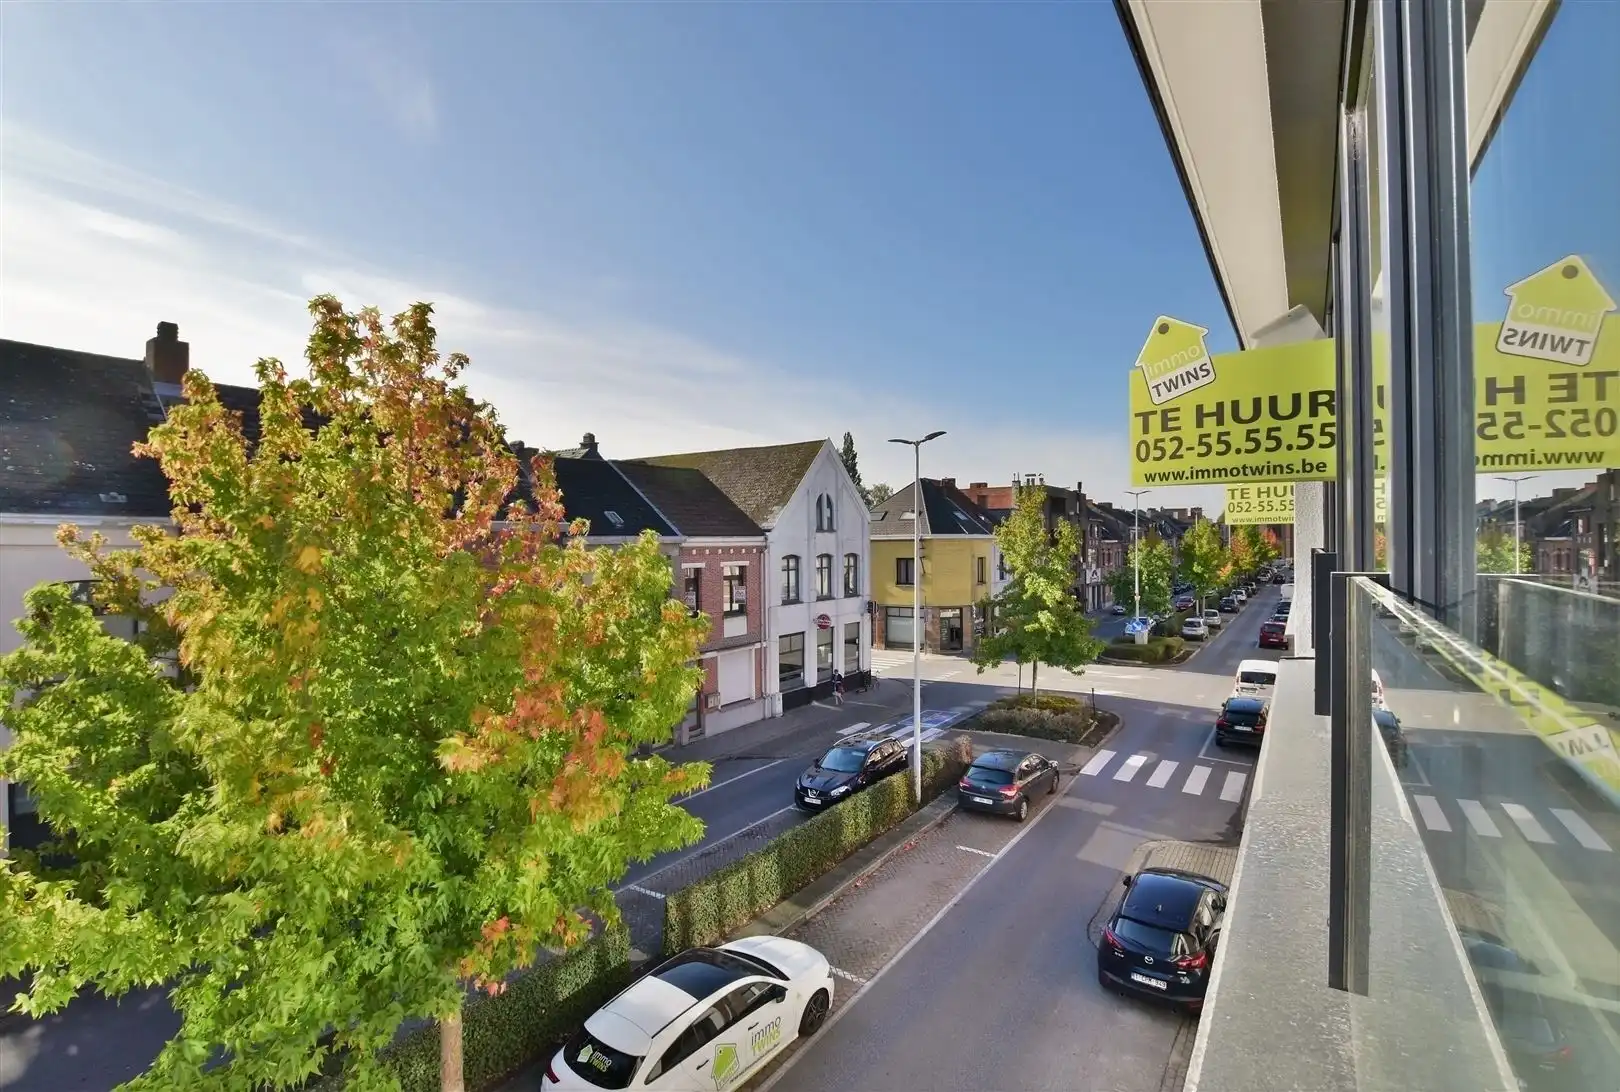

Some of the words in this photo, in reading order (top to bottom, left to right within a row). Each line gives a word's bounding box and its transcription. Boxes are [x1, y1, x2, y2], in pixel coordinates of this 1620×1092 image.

[1148, 344, 1200, 378] immo
[1152, 362, 1211, 398] TWINS
[1134, 406, 1182, 435] TE
[1195, 389, 1336, 429] HUUR
[1135, 421, 1336, 463] 052-55.55.55
[1144, 458, 1328, 483] www.immotwins.be
[1227, 487, 1251, 500] TE
[752, 1016, 781, 1047] immo
